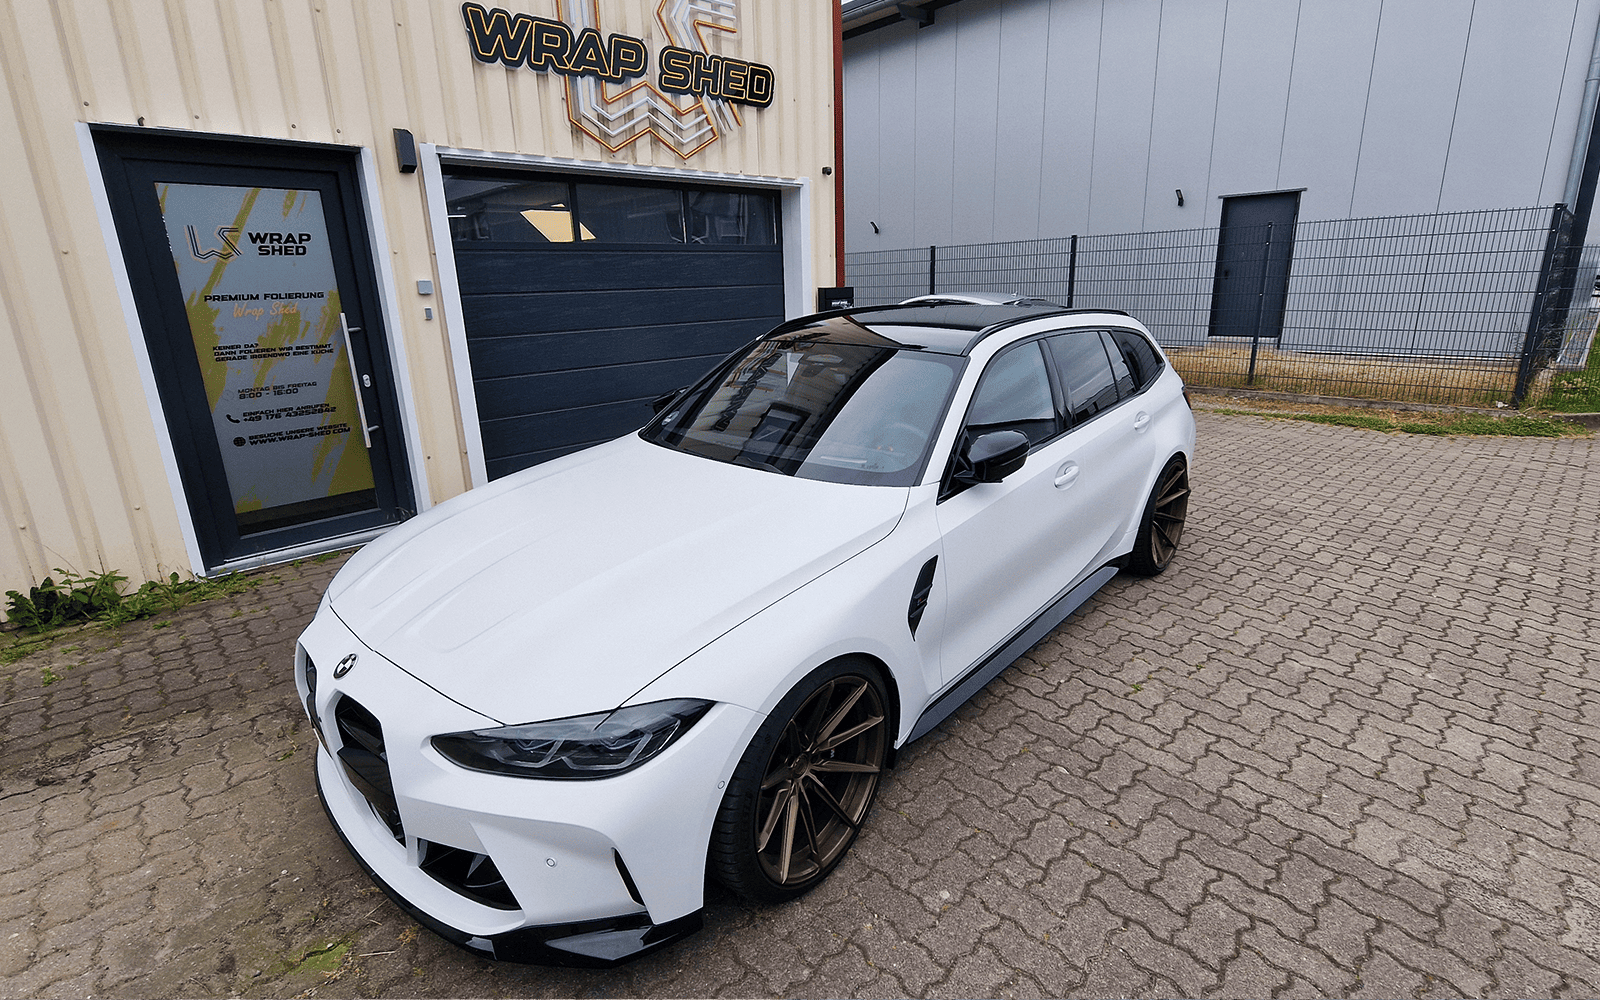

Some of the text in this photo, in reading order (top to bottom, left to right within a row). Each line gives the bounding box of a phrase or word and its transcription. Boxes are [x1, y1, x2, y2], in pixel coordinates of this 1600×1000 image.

[462, 3, 774, 108] WRAP SHED
[248, 232, 311, 245] WRAP
[258, 245, 306, 256] SHED
[204, 291, 324, 302] PREMIUM FOLIERUNG
[233, 301, 298, 320] Wrap Shed
[295, 343, 332, 351] BESTIMMT
[215, 354, 248, 362] GERADE
[250, 351, 291, 360] IRGENDWO
[238, 386, 271, 394] MONTAG
[288, 381, 317, 389] FREITAG
[239, 391, 262, 400] 8:00
[273, 387, 299, 396] 16:00
[243, 409, 275, 418] EINFACH
[296, 403, 330, 411] ANRUFEN
[243, 415, 262, 423] +49
[249, 422, 348, 441] BESUCHE UNSERE WEBSITE
